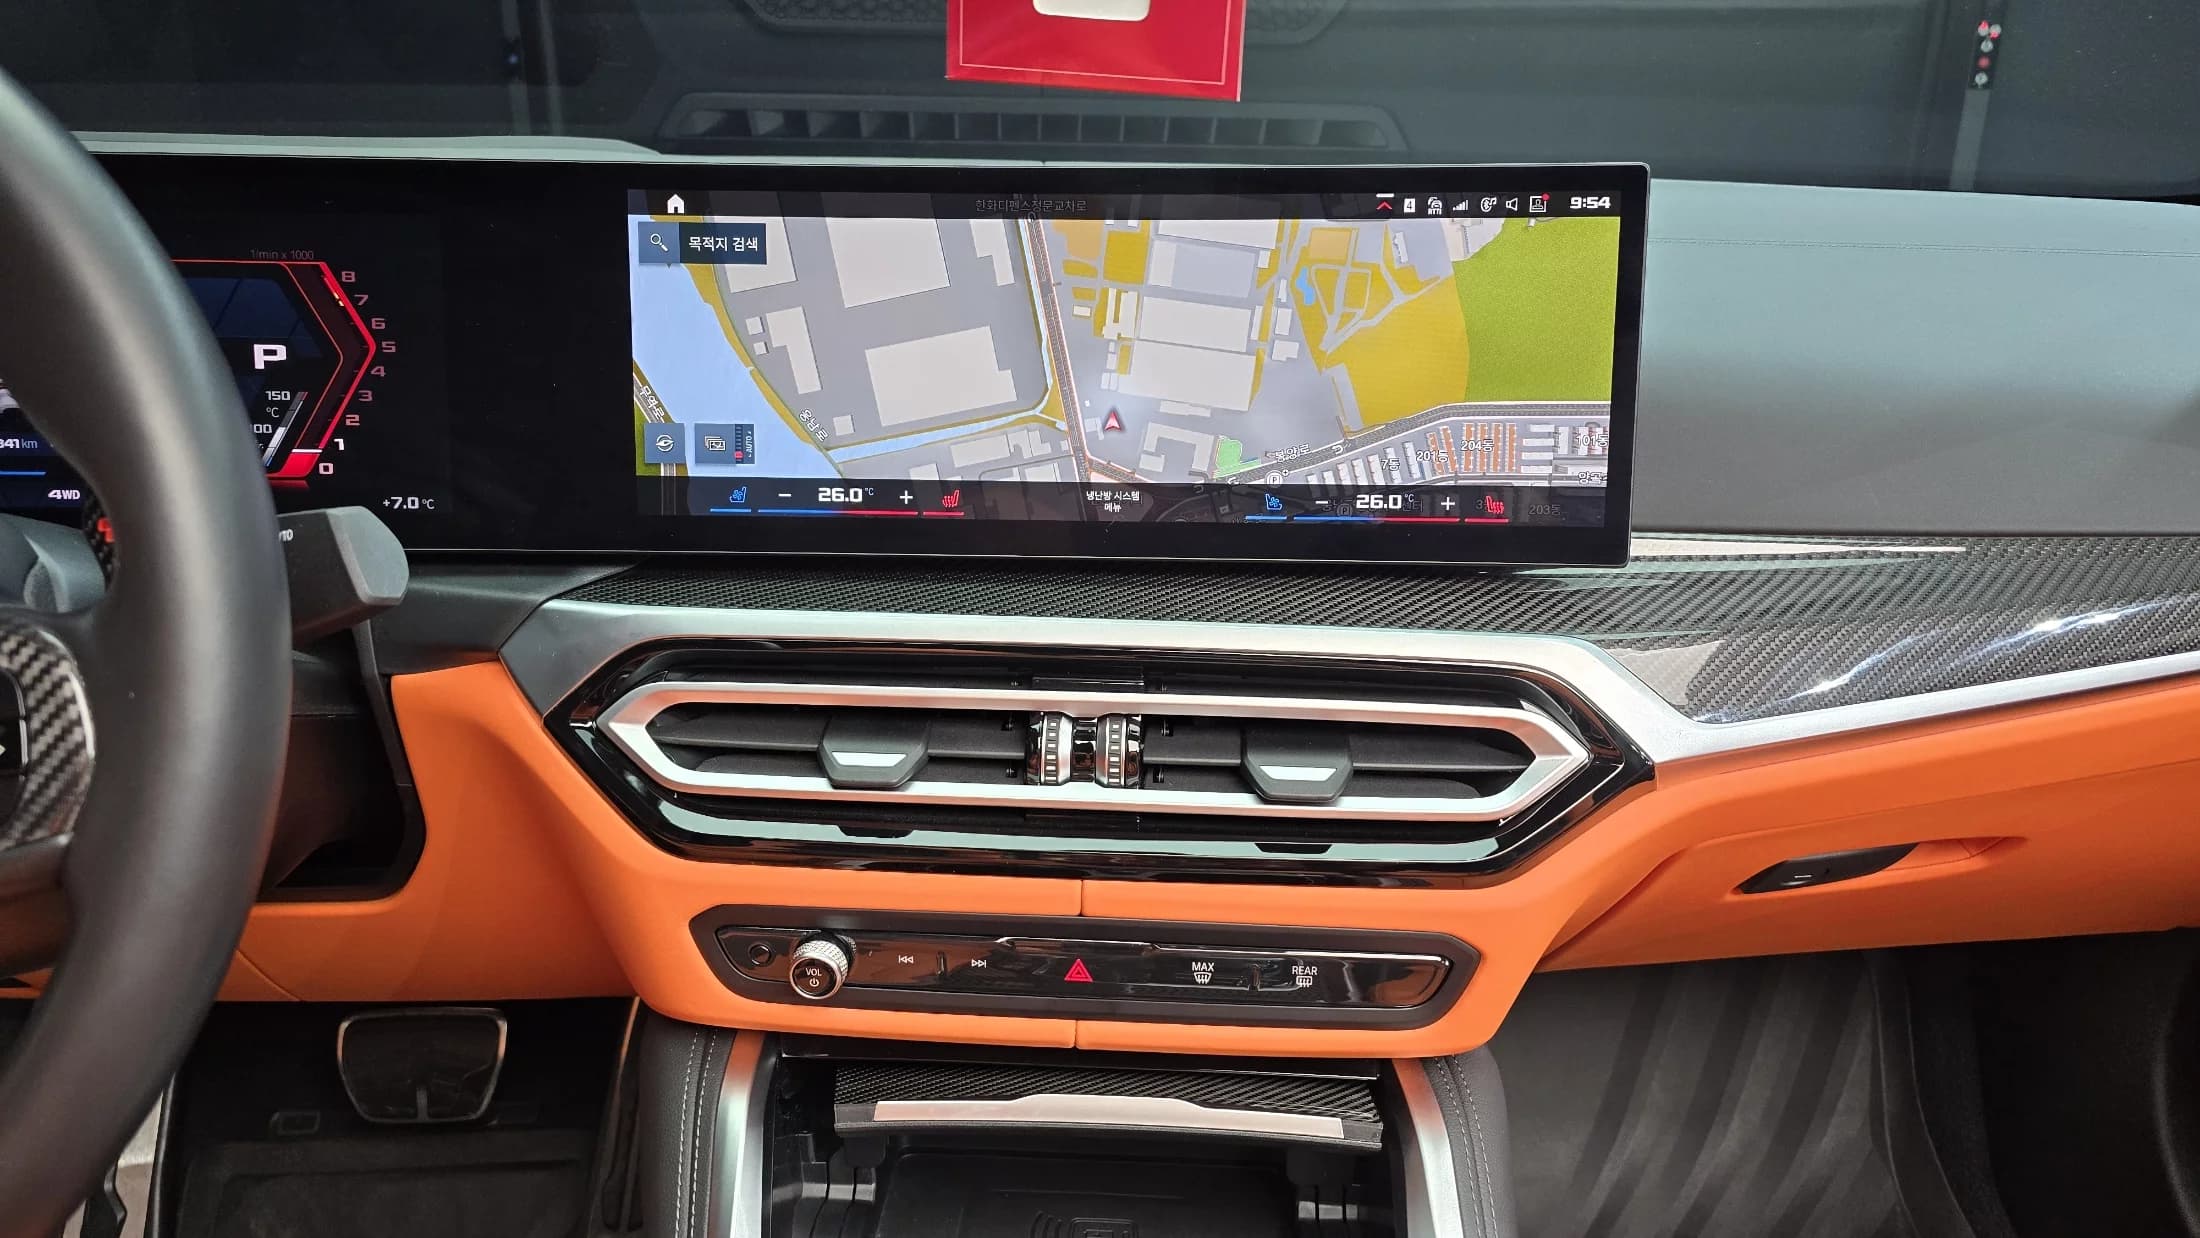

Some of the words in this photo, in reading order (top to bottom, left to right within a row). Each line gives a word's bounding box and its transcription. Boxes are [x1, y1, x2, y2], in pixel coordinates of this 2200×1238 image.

[1569, 196, 1611, 209] 9:54
[688, 236, 728, 252] 목적지
[732, 236, 758, 252] 검색
[251, 250, 279, 260] 1/min
[291, 250, 314, 260] 1000
[341, 271, 356, 283] 8
[354, 294, 369, 306] 7
[371, 317, 386, 329] 6
[381, 341, 396, 353] 5
[253, 343, 287, 370] P
[370, 365, 386, 377] 4
[265, 390, 291, 401] 150
[359, 391, 373, 402] 3
[345, 414, 360, 426] 2
[251, 423, 273, 434] 00
[21, 438, 38, 449] km
[333, 438, 345, 451] 1
[745, 435, 753, 453] AUTO
[1460, 439, 1494, 452] 204동
[1576, 433, 1609, 447] 101동
[1416, 450, 1449, 463] 201동
[318, 462, 334, 475] 0
[1381, 458, 1401, 471] 7동
[48, 489, 81, 500] 4WD
[818, 487, 863, 502] 26.0
[1086, 490, 1112, 501] 냉난방
[1114, 490, 1140, 501] 시스템
[1356, 494, 1402, 509] 26.0
[1104, 503, 1122, 513] 메뉴
[1529, 504, 1561, 517] 203동
[805, 967, 822, 977] VOL
[1191, 961, 1215, 972] MAX
[1292, 965, 1318, 976] REAR
